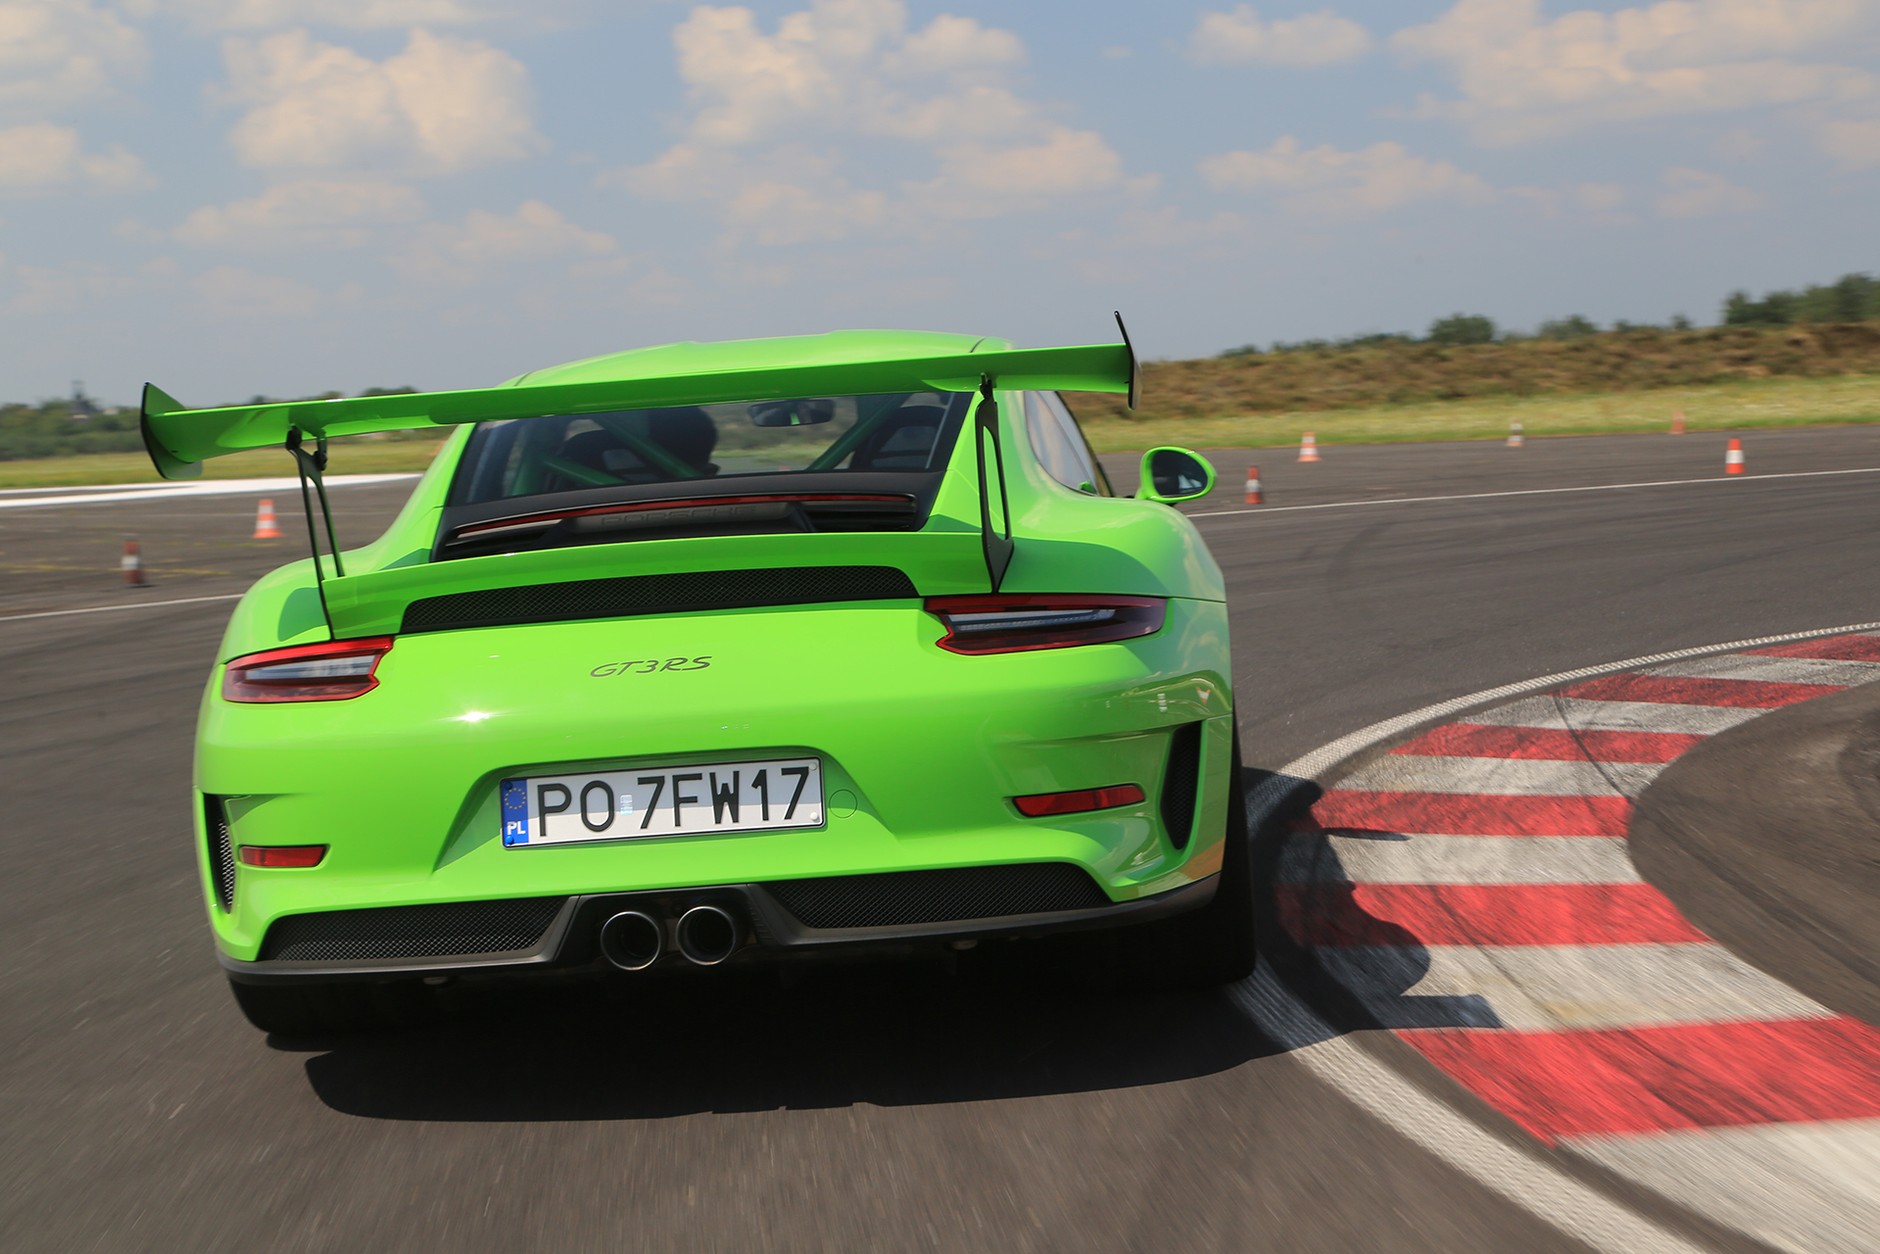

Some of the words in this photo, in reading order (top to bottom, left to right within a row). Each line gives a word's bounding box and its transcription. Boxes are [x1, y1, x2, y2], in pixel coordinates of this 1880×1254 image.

[537, 780, 615, 837] PO
[637, 767, 810, 829] 7FW17
[507, 821, 526, 836] PL
